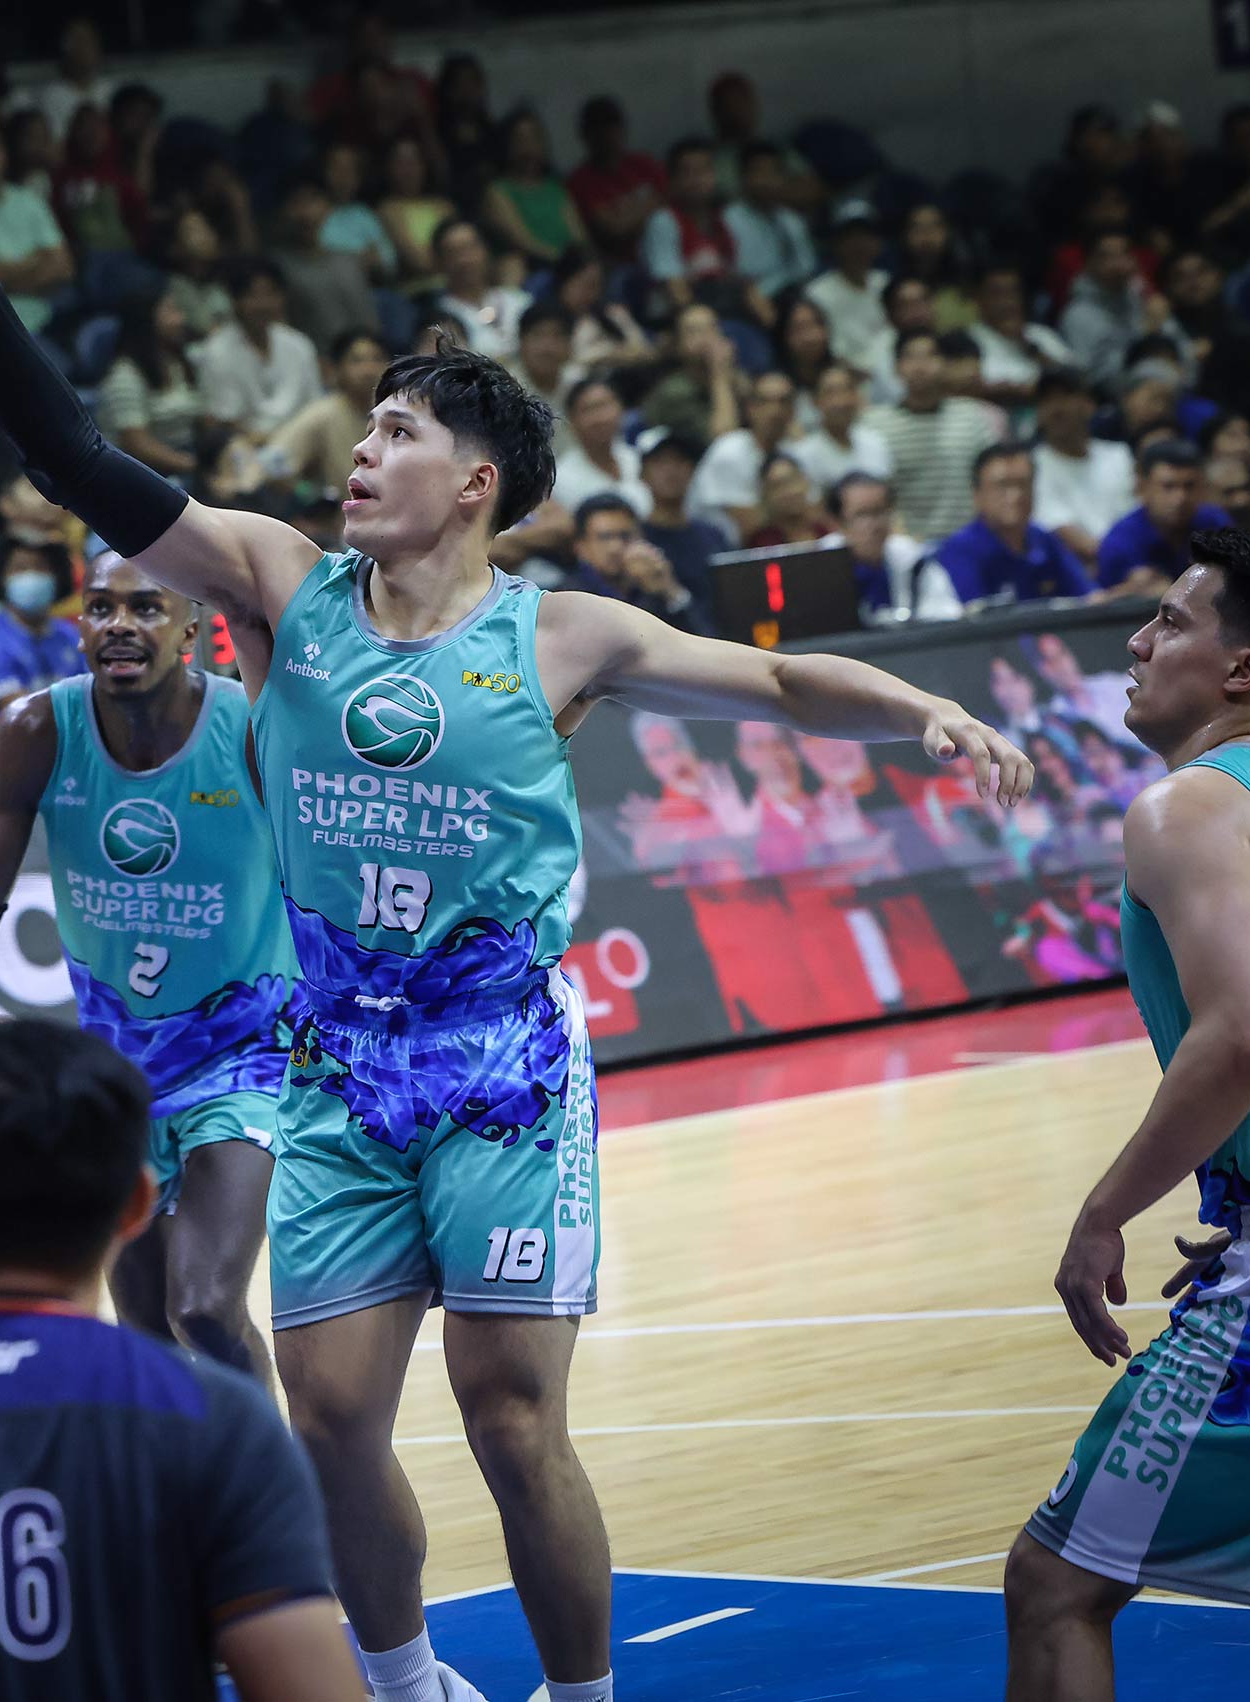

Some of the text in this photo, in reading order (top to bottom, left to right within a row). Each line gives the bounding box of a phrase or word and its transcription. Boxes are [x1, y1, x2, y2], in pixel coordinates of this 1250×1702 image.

[285, 658, 331, 681] Antbox
[461, 669, 521, 694] PBA50
[291, 767, 494, 811] PHOENIX
[297, 795, 490, 842] SUPER LPG
[66, 868, 224, 901] PHOENIX
[70, 888, 224, 925] SUPER LPG
[128, 941, 171, 999] 2
[558, 1041, 582, 1228] PHOENIX
[579, 1111, 592, 1228] SUPER
[482, 1226, 549, 1283] 18
[1135, 1361, 1218, 1494] SUPER
